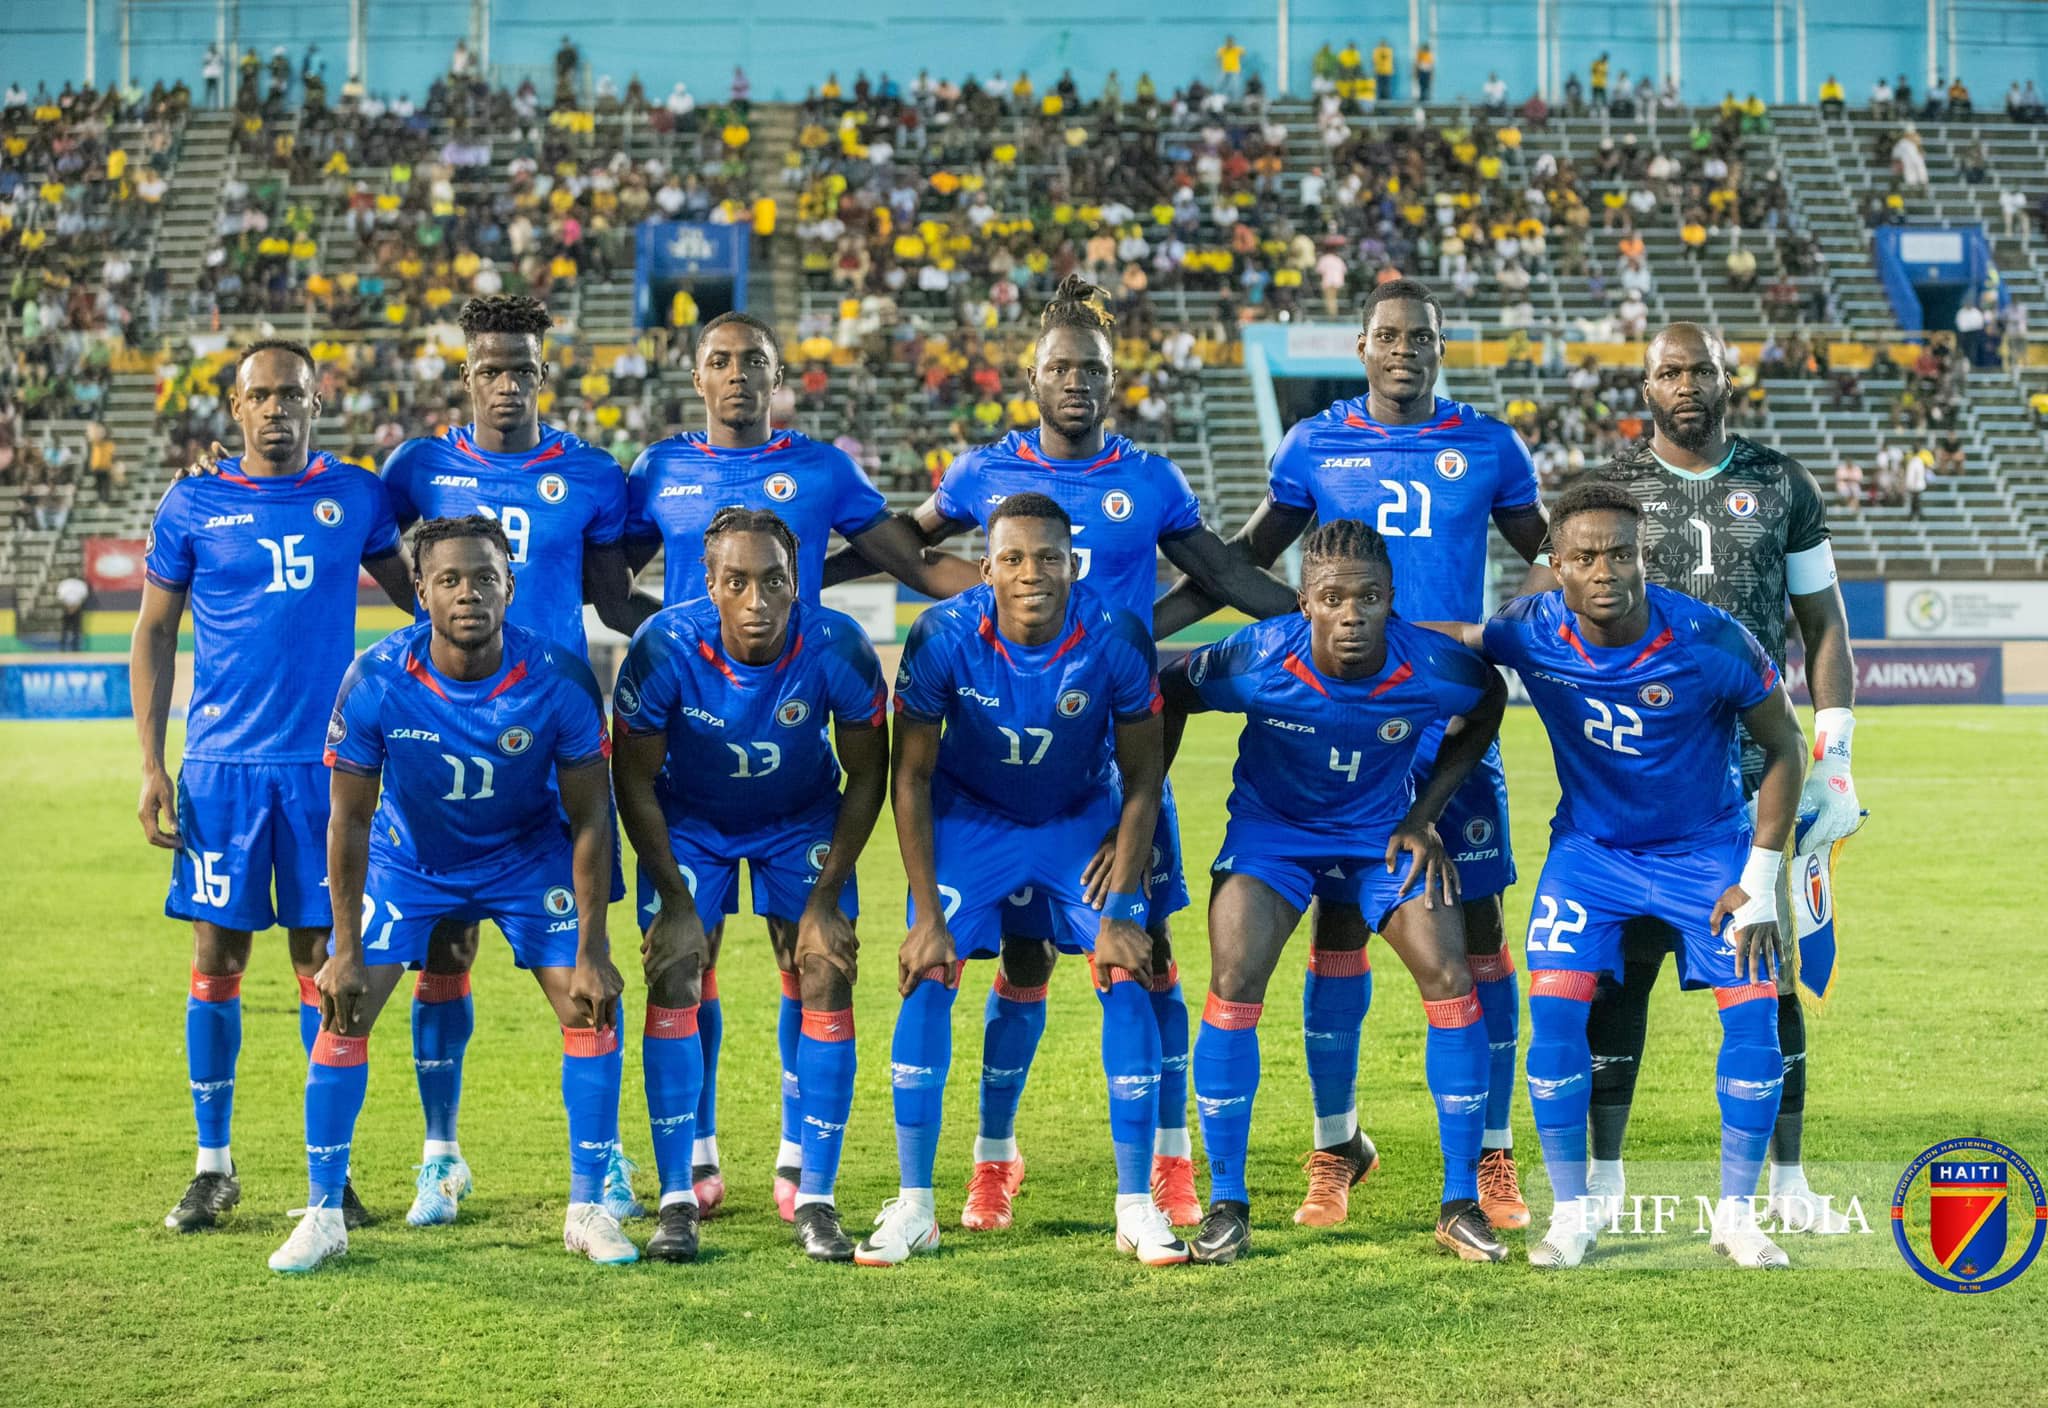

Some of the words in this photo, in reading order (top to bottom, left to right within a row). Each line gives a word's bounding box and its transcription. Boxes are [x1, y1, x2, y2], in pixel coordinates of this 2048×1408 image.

[1320, 457, 1372, 468] SAETA
[430, 475, 478, 489] SAETA
[659, 485, 703, 497] SAETA
[204, 513, 255, 529] SAETA
[1377, 479, 1433, 538] 21
[1642, 501, 1669, 512] ETA
[477, 504, 531, 564] 9
[1688, 518, 1715, 575] 1
[257, 534, 314, 593] 15
[1866, 662, 1977, 688] AIRWAYS
[387, 728, 440, 743] SAETA
[997, 725, 1054, 765] 17
[1264, 718, 1316, 735] SAETA
[1583, 697, 1643, 756] 22
[441, 753, 495, 800] 11
[726, 741, 781, 778] 13
[1328, 746, 1362, 783] 4
[1453, 848, 1499, 862] SAETA
[187, 848, 231, 908] 15
[547, 918, 579, 934] SAE
[1526, 895, 1588, 954] 22
